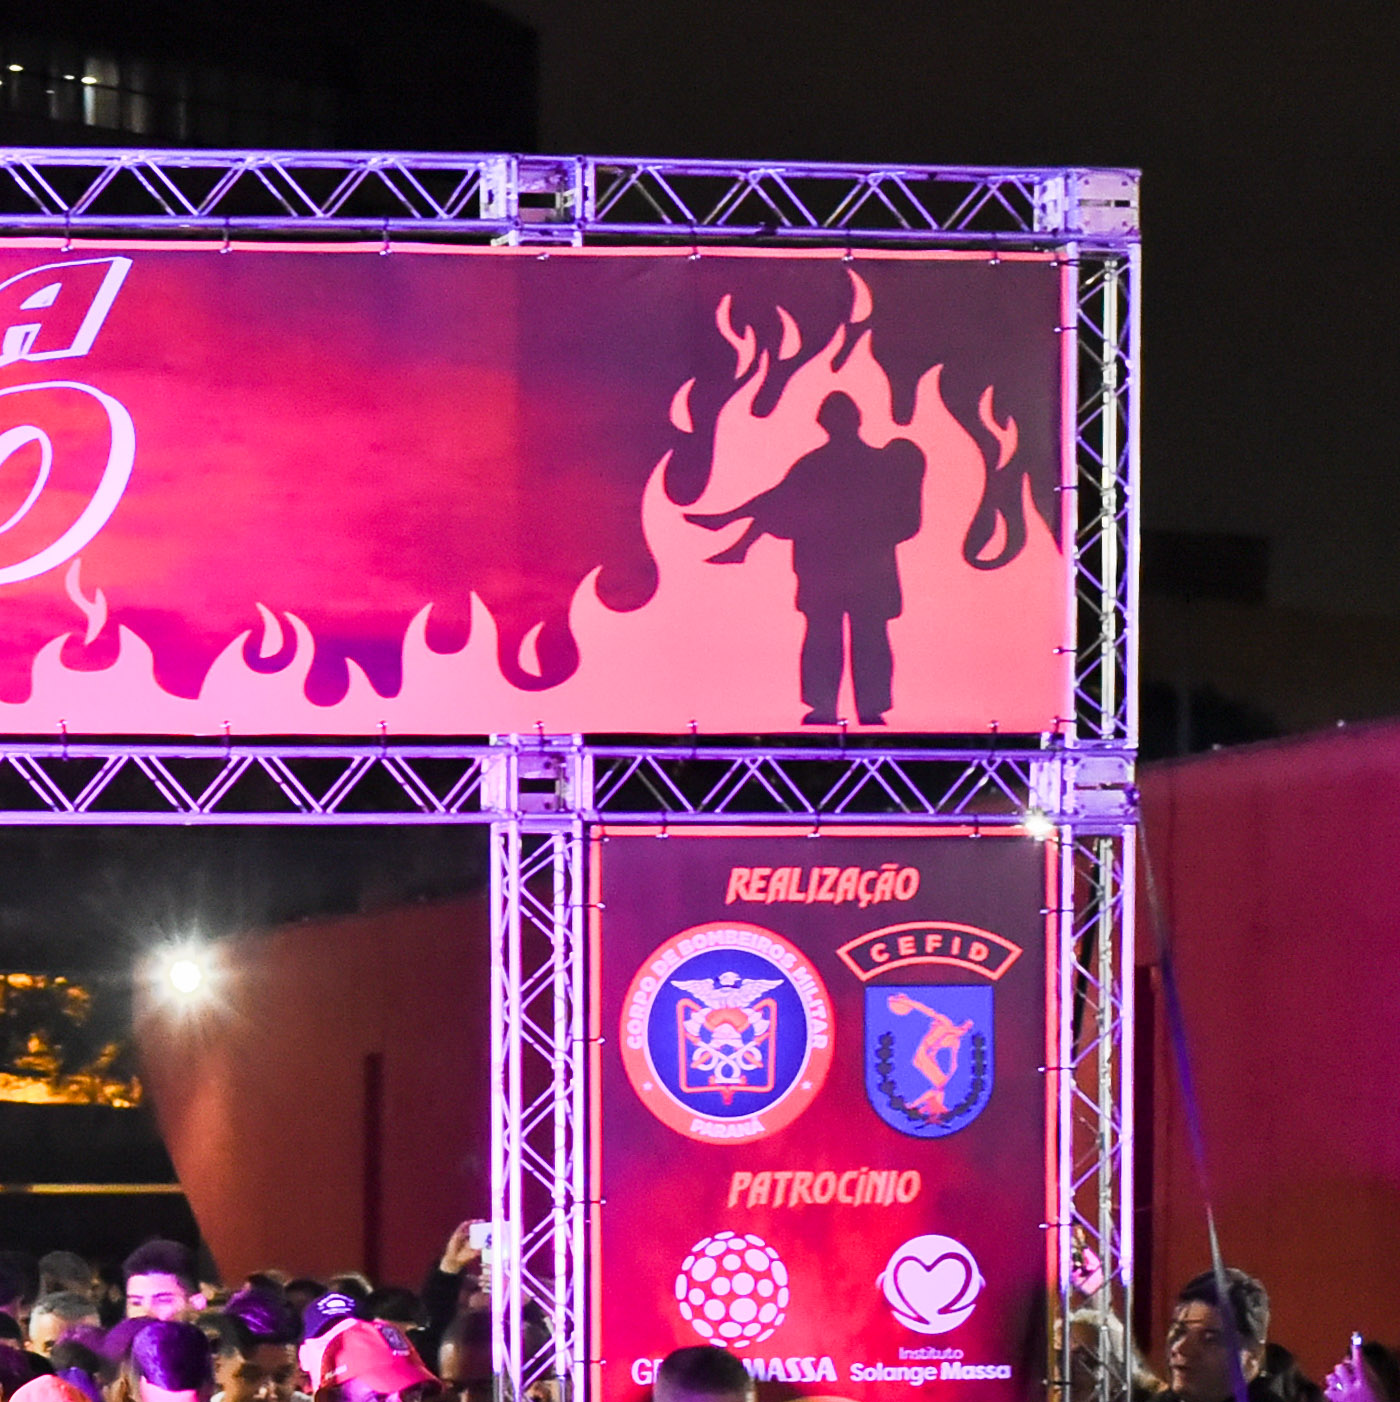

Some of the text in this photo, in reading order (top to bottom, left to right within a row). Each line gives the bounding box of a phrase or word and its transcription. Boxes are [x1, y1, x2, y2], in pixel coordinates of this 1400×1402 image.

[726, 864, 920, 908] REALIZAÇÃO
[870, 934, 989, 963] CEFID
[627, 976, 657, 1049] CORPO
[650, 948, 680, 974] DE
[791, 966, 828, 1049] MILITAR
[727, 1167, 921, 1208] PATROCÍNIO
[898, 1347, 963, 1360] Instituto
[850, 1362, 1011, 1386] Solange Massa
